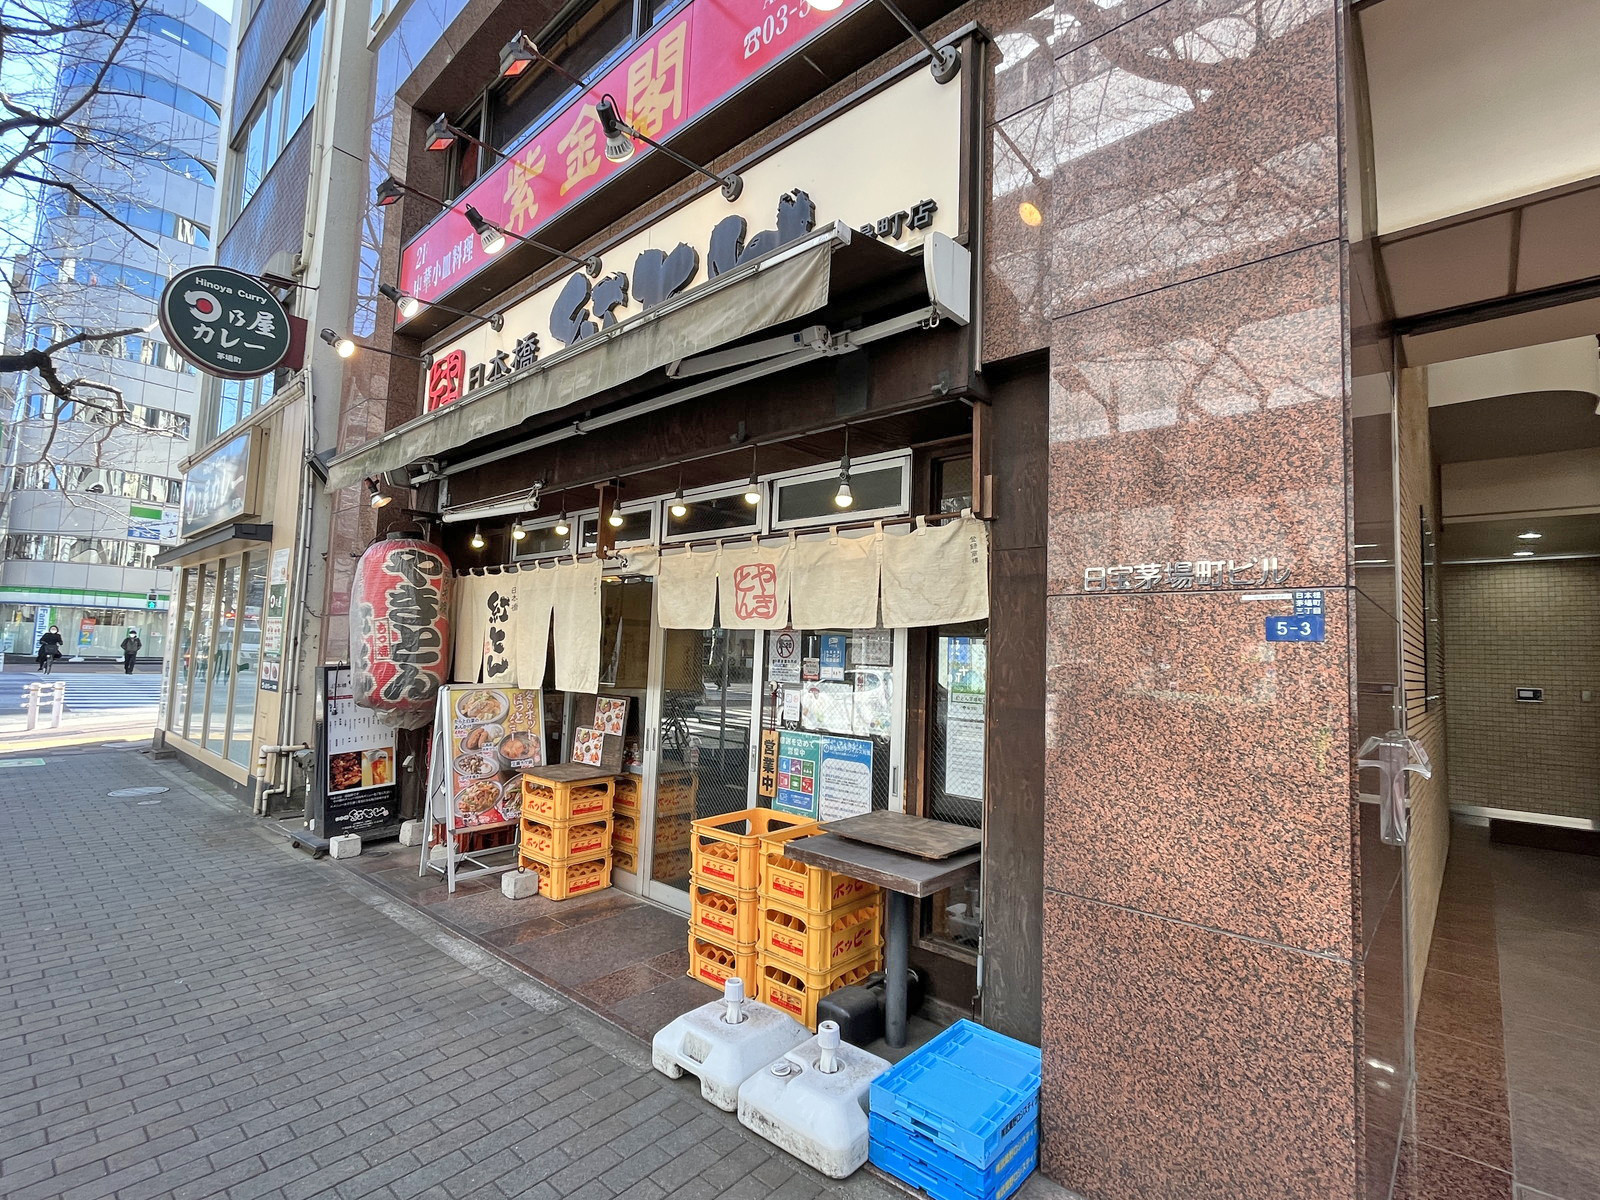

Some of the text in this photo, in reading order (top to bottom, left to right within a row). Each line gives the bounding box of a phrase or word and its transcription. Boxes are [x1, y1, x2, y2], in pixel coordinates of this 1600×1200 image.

[503, 21, 688, 232] 紫金閣
[195, 276, 268, 305] Hinoya Curry
[193, 323, 266, 350] カレー
[1084, 557, 1292, 592] 日宝茅場町ビル
[382, 549, 443, 701] やきとん
[1276, 621, 1312, 635] 5-3
[762, 739, 776, 792] 営業中
[527, 800, 552, 814] ホッピー
[525, 837, 551, 852] ホッピー
[832, 927, 872, 958] ホッピー
